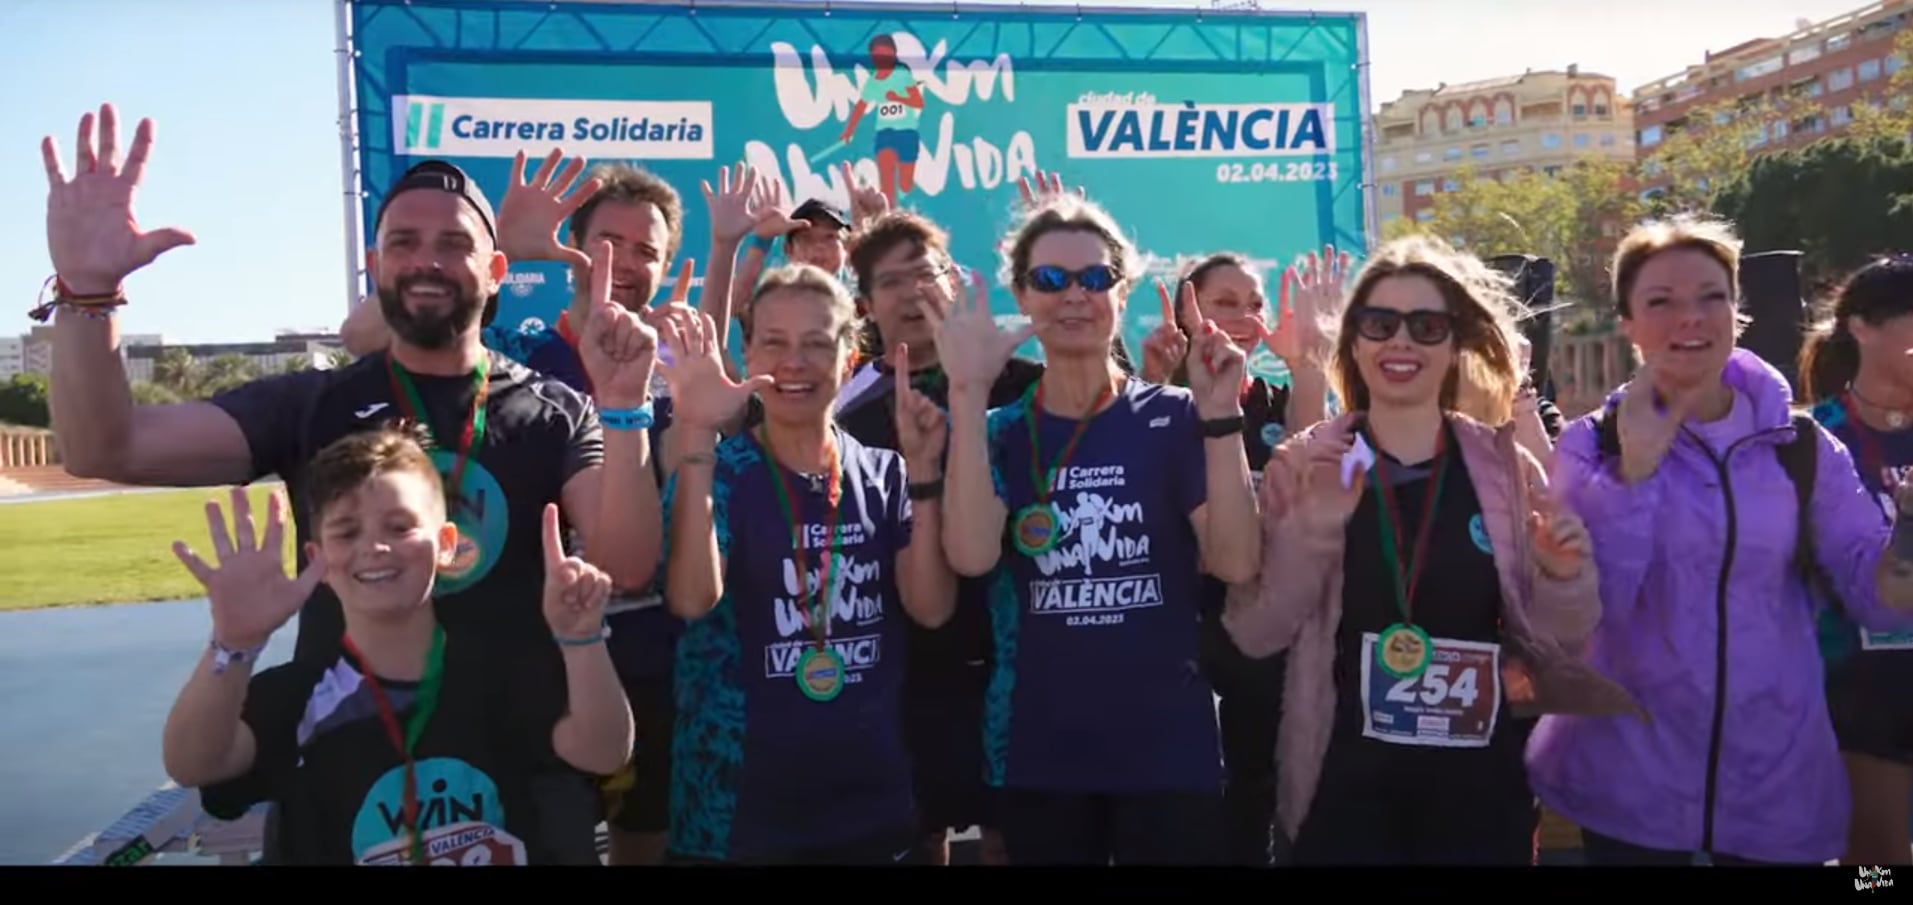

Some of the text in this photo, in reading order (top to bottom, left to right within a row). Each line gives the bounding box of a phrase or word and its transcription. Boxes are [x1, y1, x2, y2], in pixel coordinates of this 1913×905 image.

[880, 104, 904, 117] 001
[452, 114, 703, 142] Carrera Solidaria
[1077, 101, 1327, 152] VALÈNCIA
[1216, 162, 1338, 182] 02.04.2023
[1068, 465, 1125, 479] Carrera
[1068, 476, 1126, 490] Solidaria
[1035, 578, 1160, 610] VALÈNCIA
